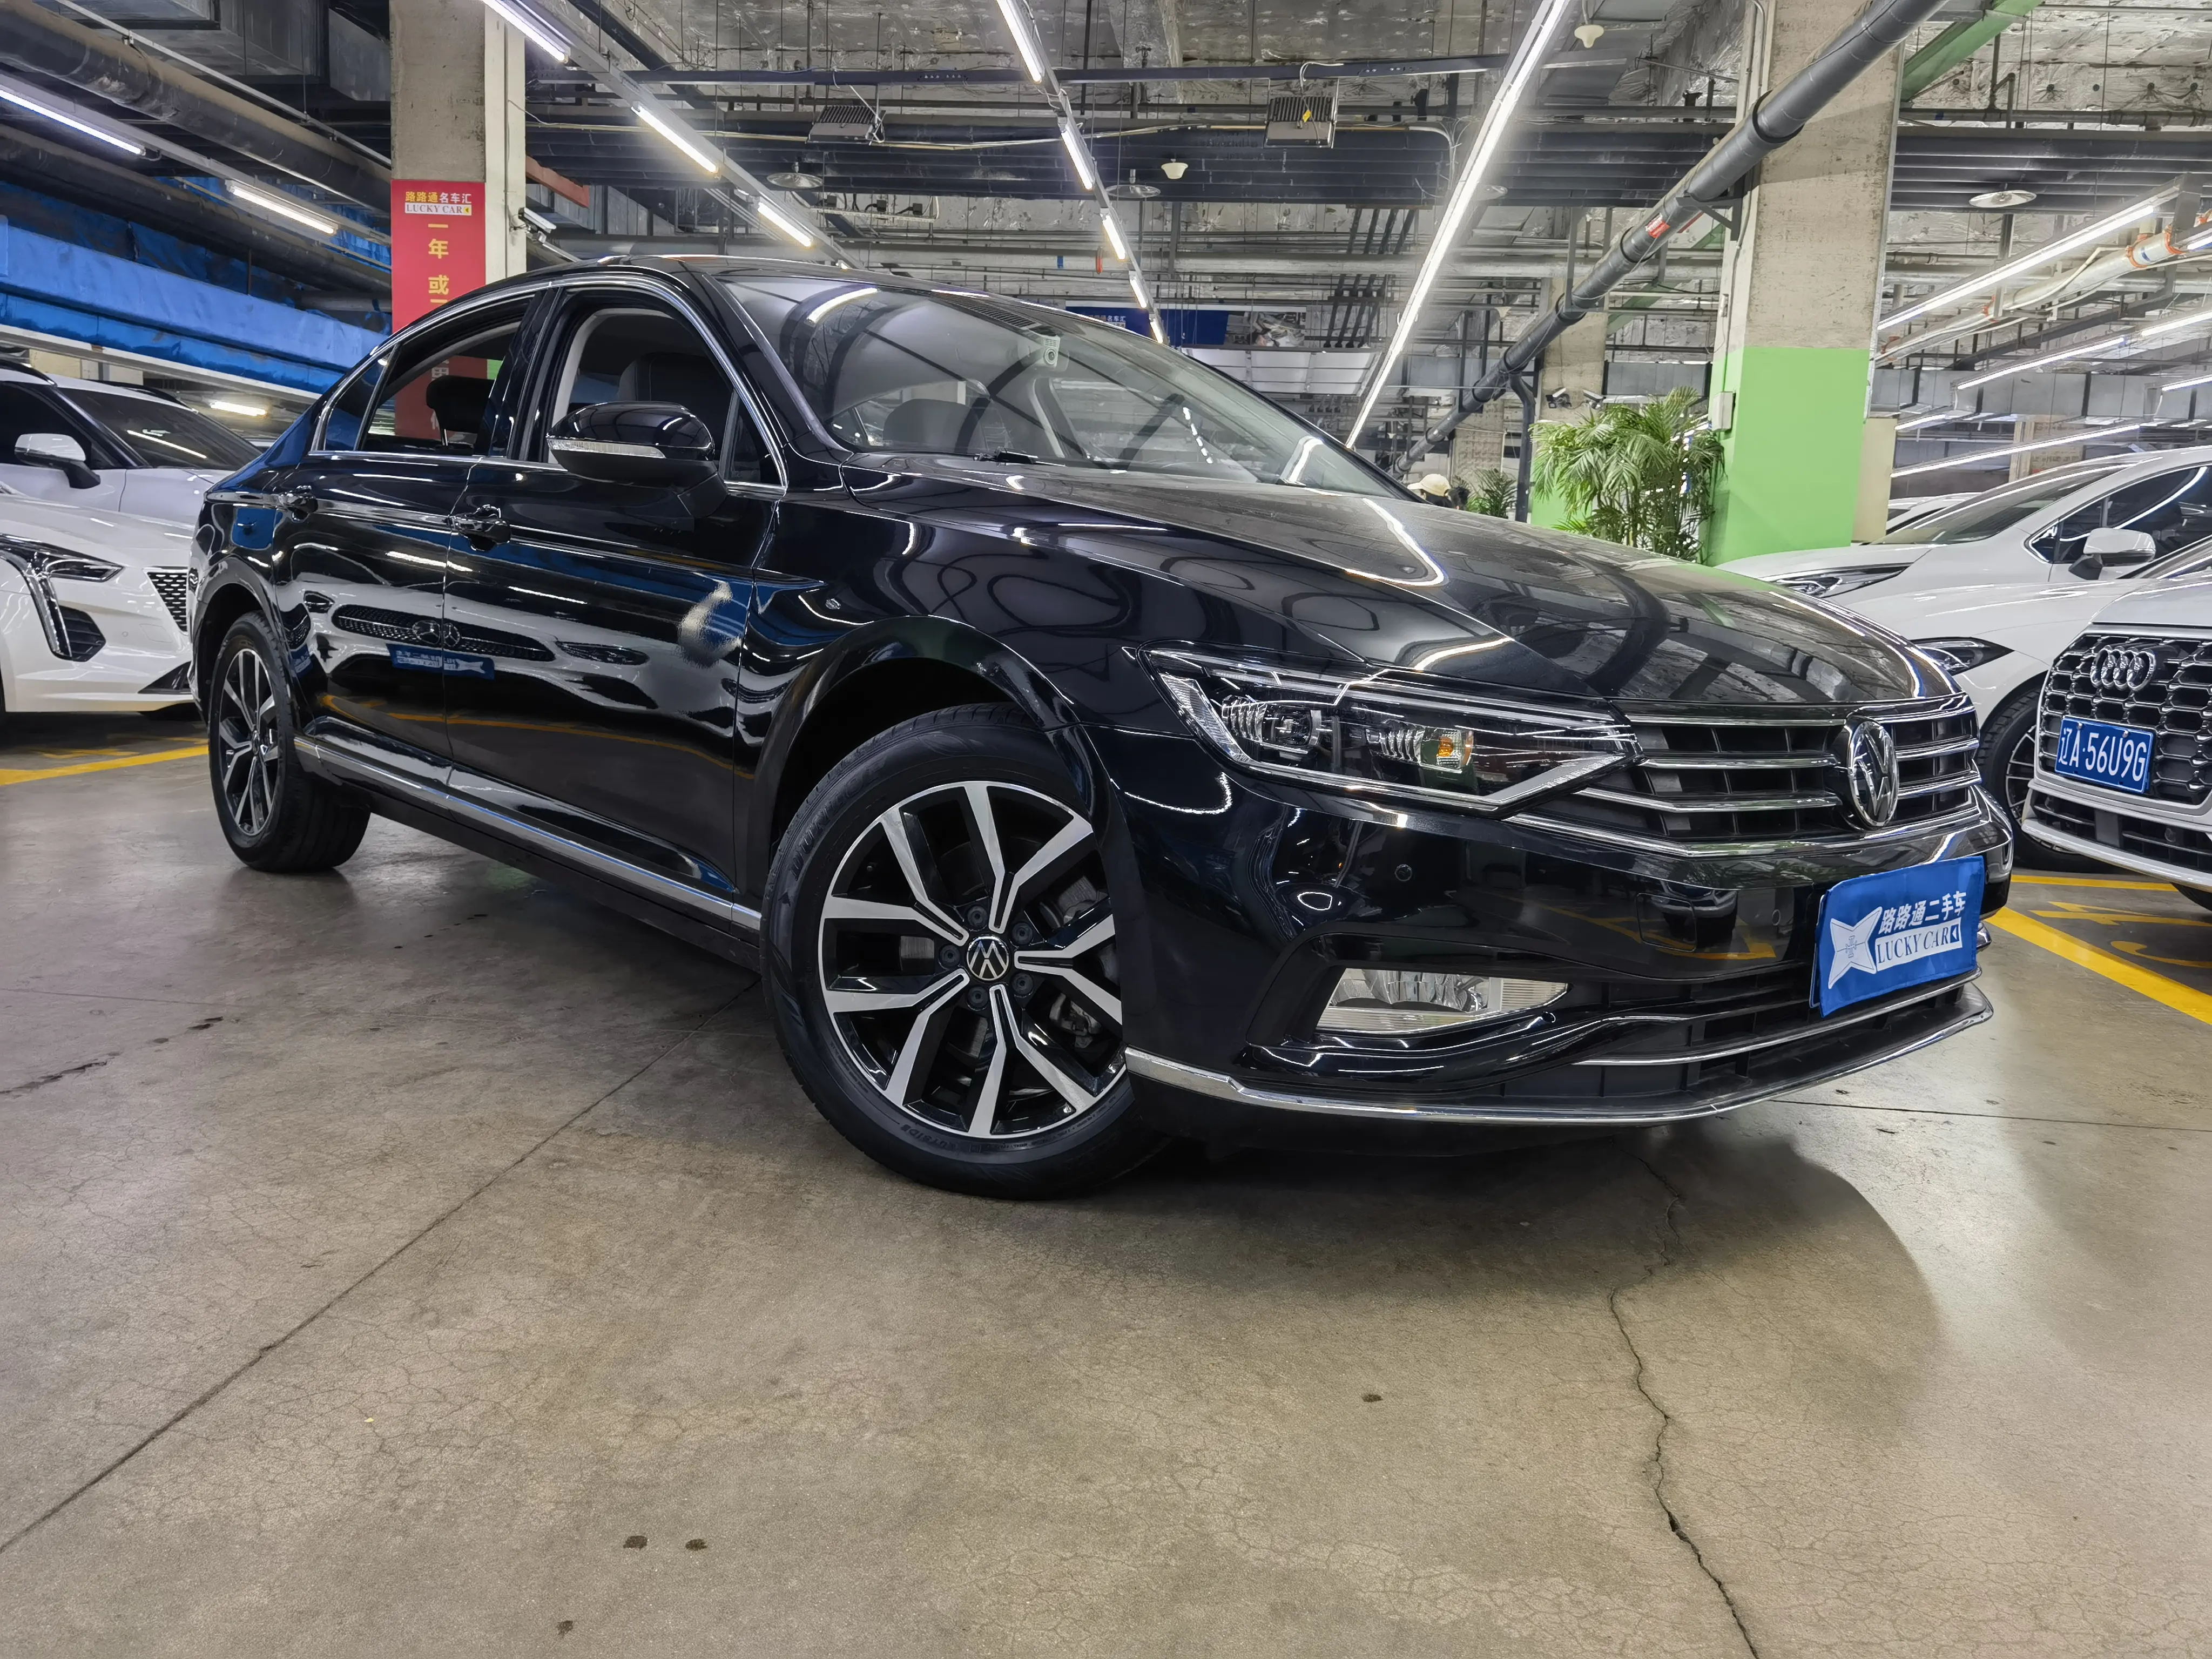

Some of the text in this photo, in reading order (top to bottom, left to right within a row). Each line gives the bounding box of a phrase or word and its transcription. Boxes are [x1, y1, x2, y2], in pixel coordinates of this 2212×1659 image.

[405, 191, 472, 204] 路路通名车汇
[406, 205, 463, 214] LUCKY CAR
[1878, 891, 1966, 935] 路路通二手车
[1877, 927, 1950, 964] LUCKY CAR
